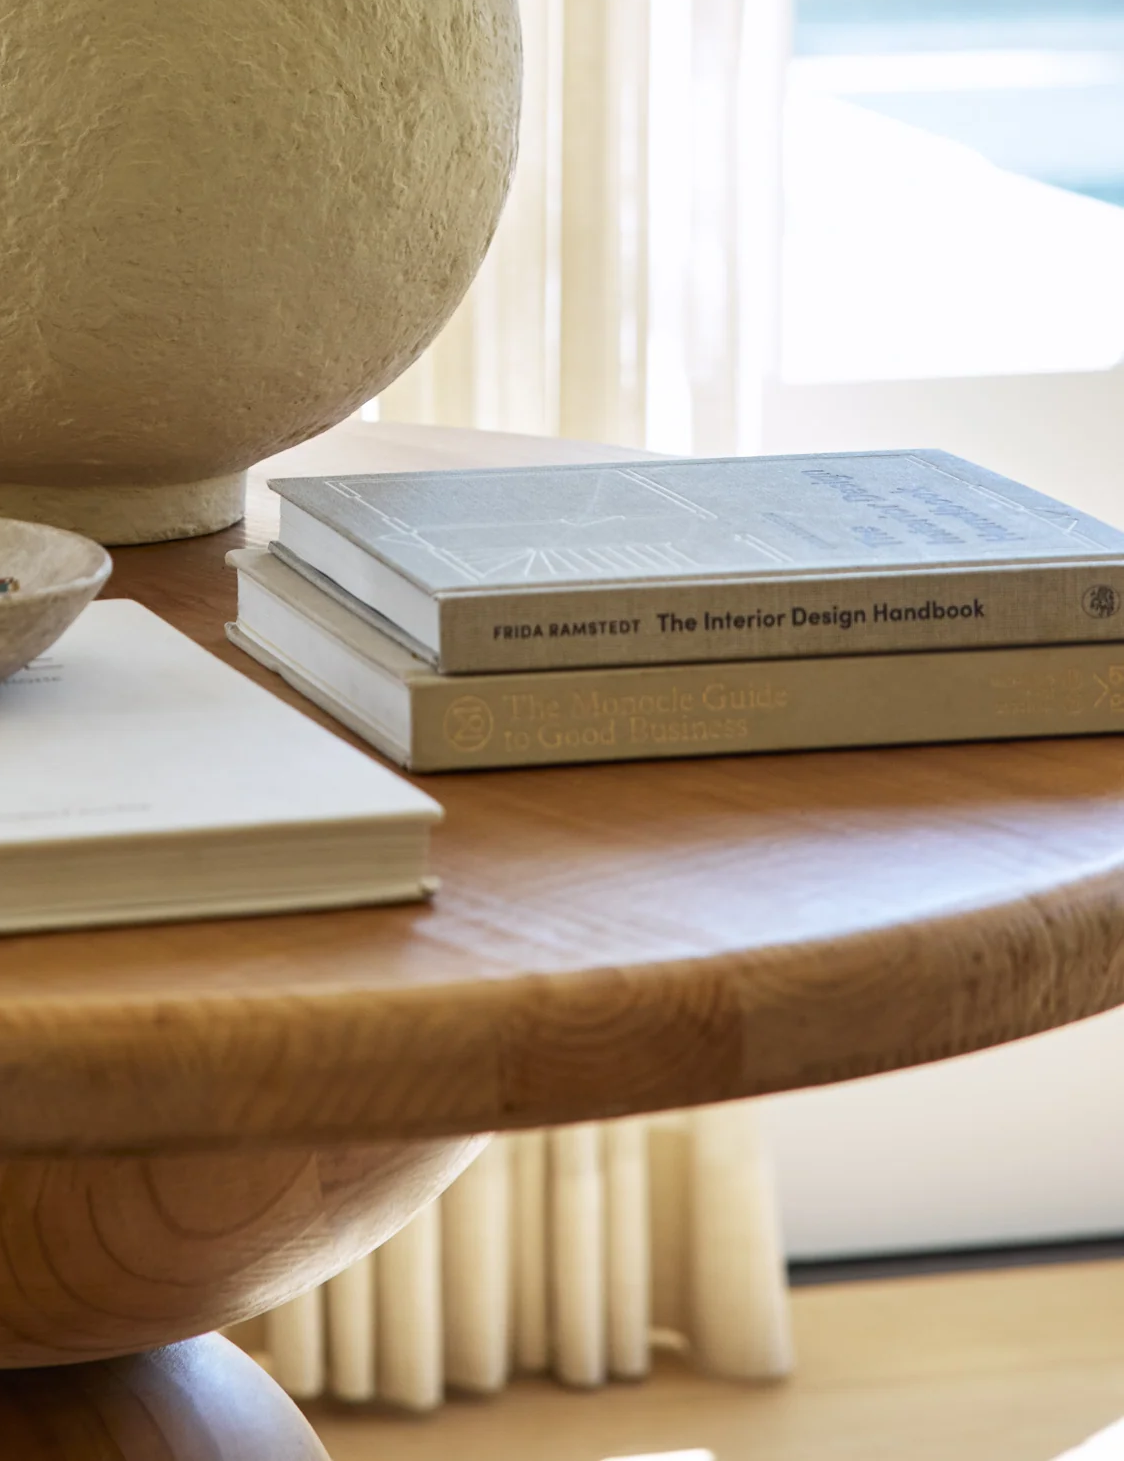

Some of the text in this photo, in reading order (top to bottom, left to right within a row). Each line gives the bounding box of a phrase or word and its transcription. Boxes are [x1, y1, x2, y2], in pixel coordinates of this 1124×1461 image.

[492, 598, 985, 640] FRIDA RAMSTEDT The Interior Design Handbook
[502, 680, 790, 722] The Monocle Guide
[503, 713, 750, 753] to Good Business
